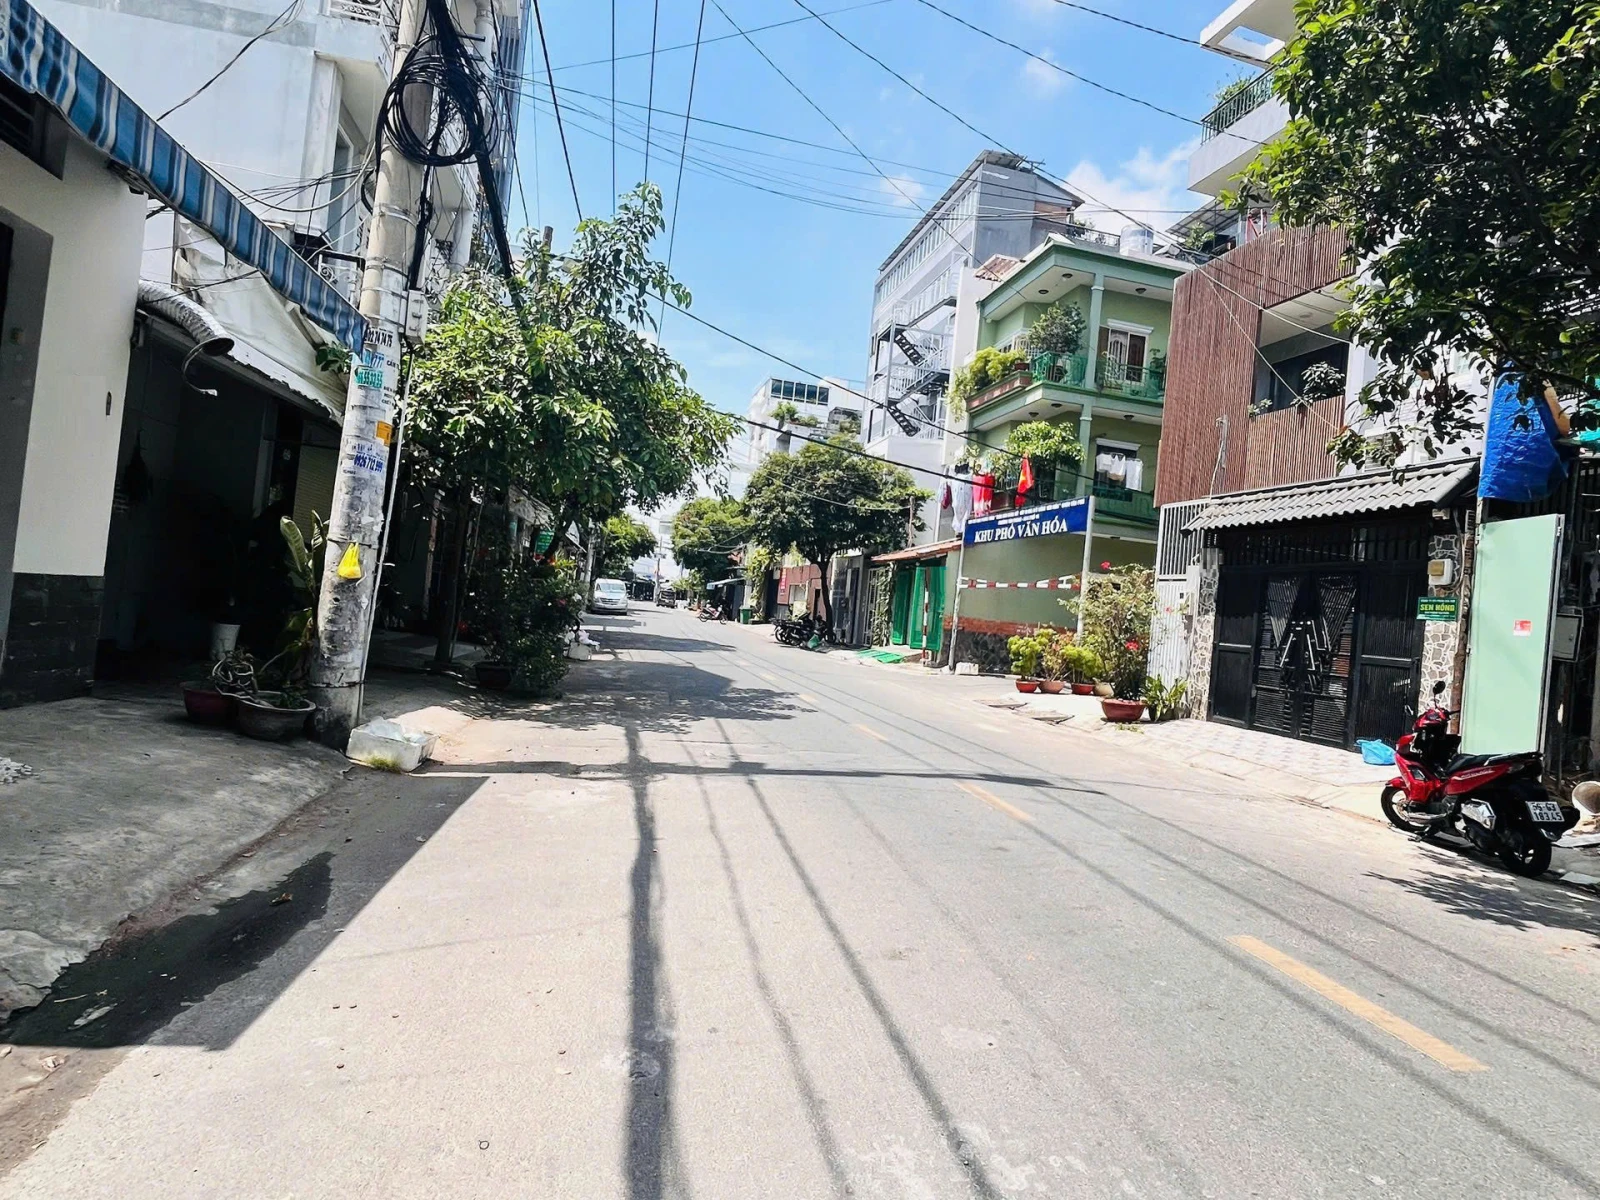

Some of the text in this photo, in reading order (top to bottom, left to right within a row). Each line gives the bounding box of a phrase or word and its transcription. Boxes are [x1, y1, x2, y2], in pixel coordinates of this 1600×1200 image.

[974, 528, 993, 543] KHU
[1018, 521, 1040, 538] VĂN
[1041, 515, 1068, 535] HÓA
